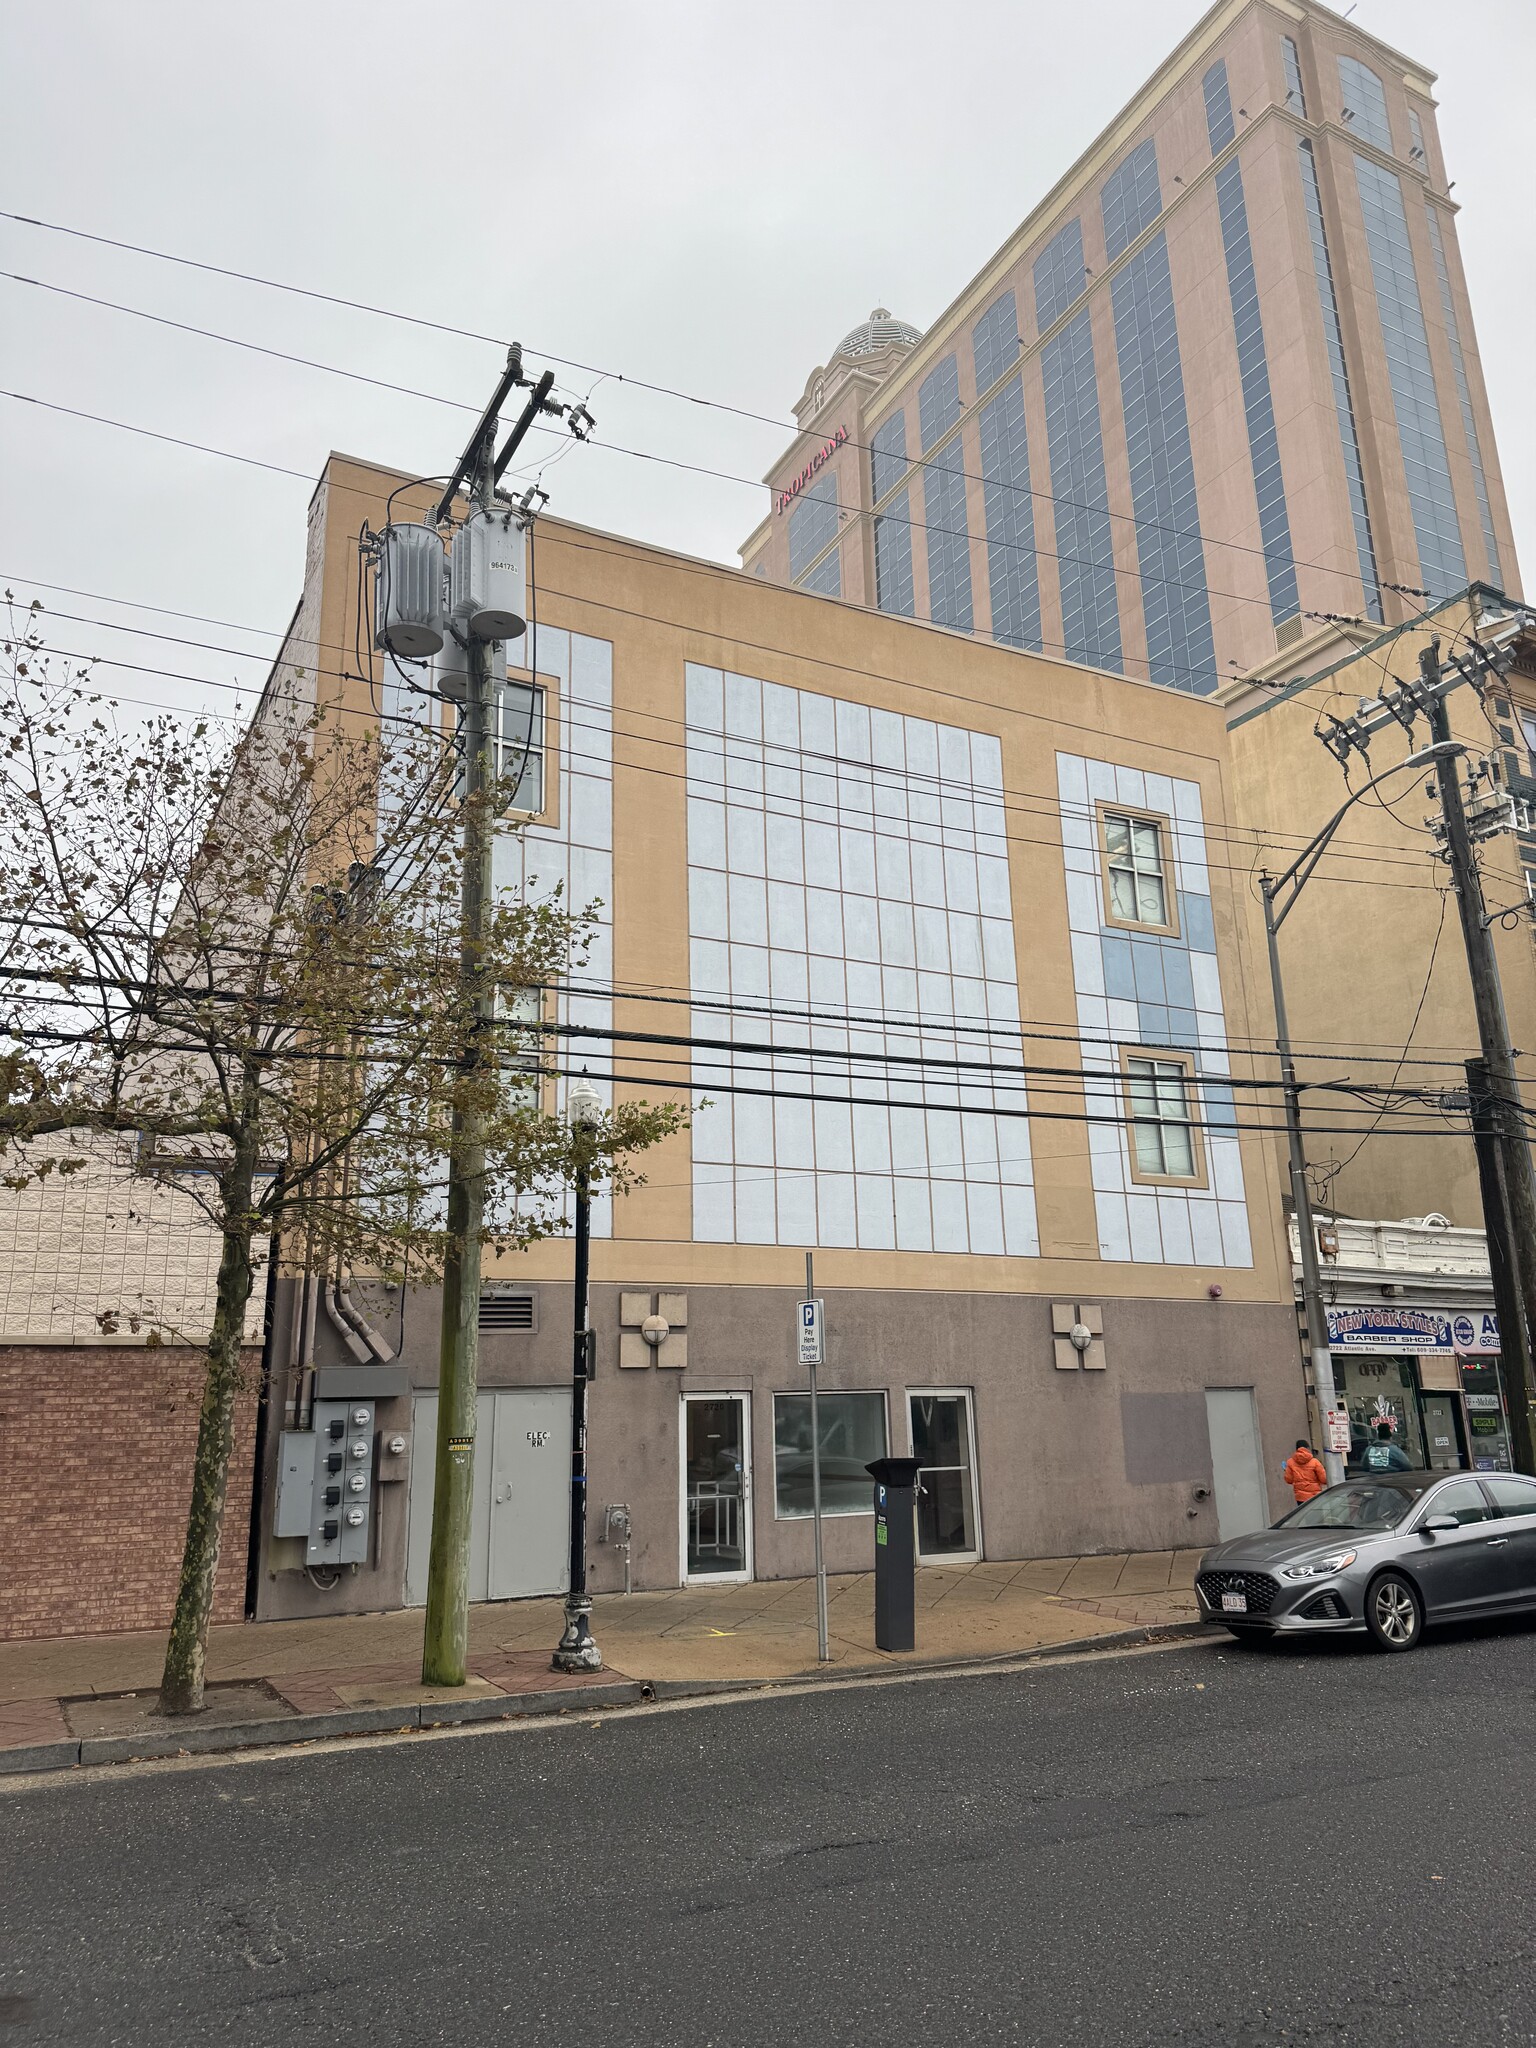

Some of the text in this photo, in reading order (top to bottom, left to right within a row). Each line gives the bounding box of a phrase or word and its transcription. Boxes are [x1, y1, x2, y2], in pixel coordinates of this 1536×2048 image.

[775, 424, 850, 516] TROPICANA
[805, 1307, 813, 1325] P
[1337, 1313, 1363, 1334] NEW
[1365, 1311, 1400, 1328] YORK
[1401, 1313, 1439, 1336] STYLES
[804, 1328, 814, 1336] Pay
[1346, 1335, 1397, 1343] BARBER
[801, 1344, 818, 1352] Display
[526, 1431, 550, 1440] ELEC.
[531, 1440, 545, 1448] RM.
[879, 1485, 886, 1503] P
